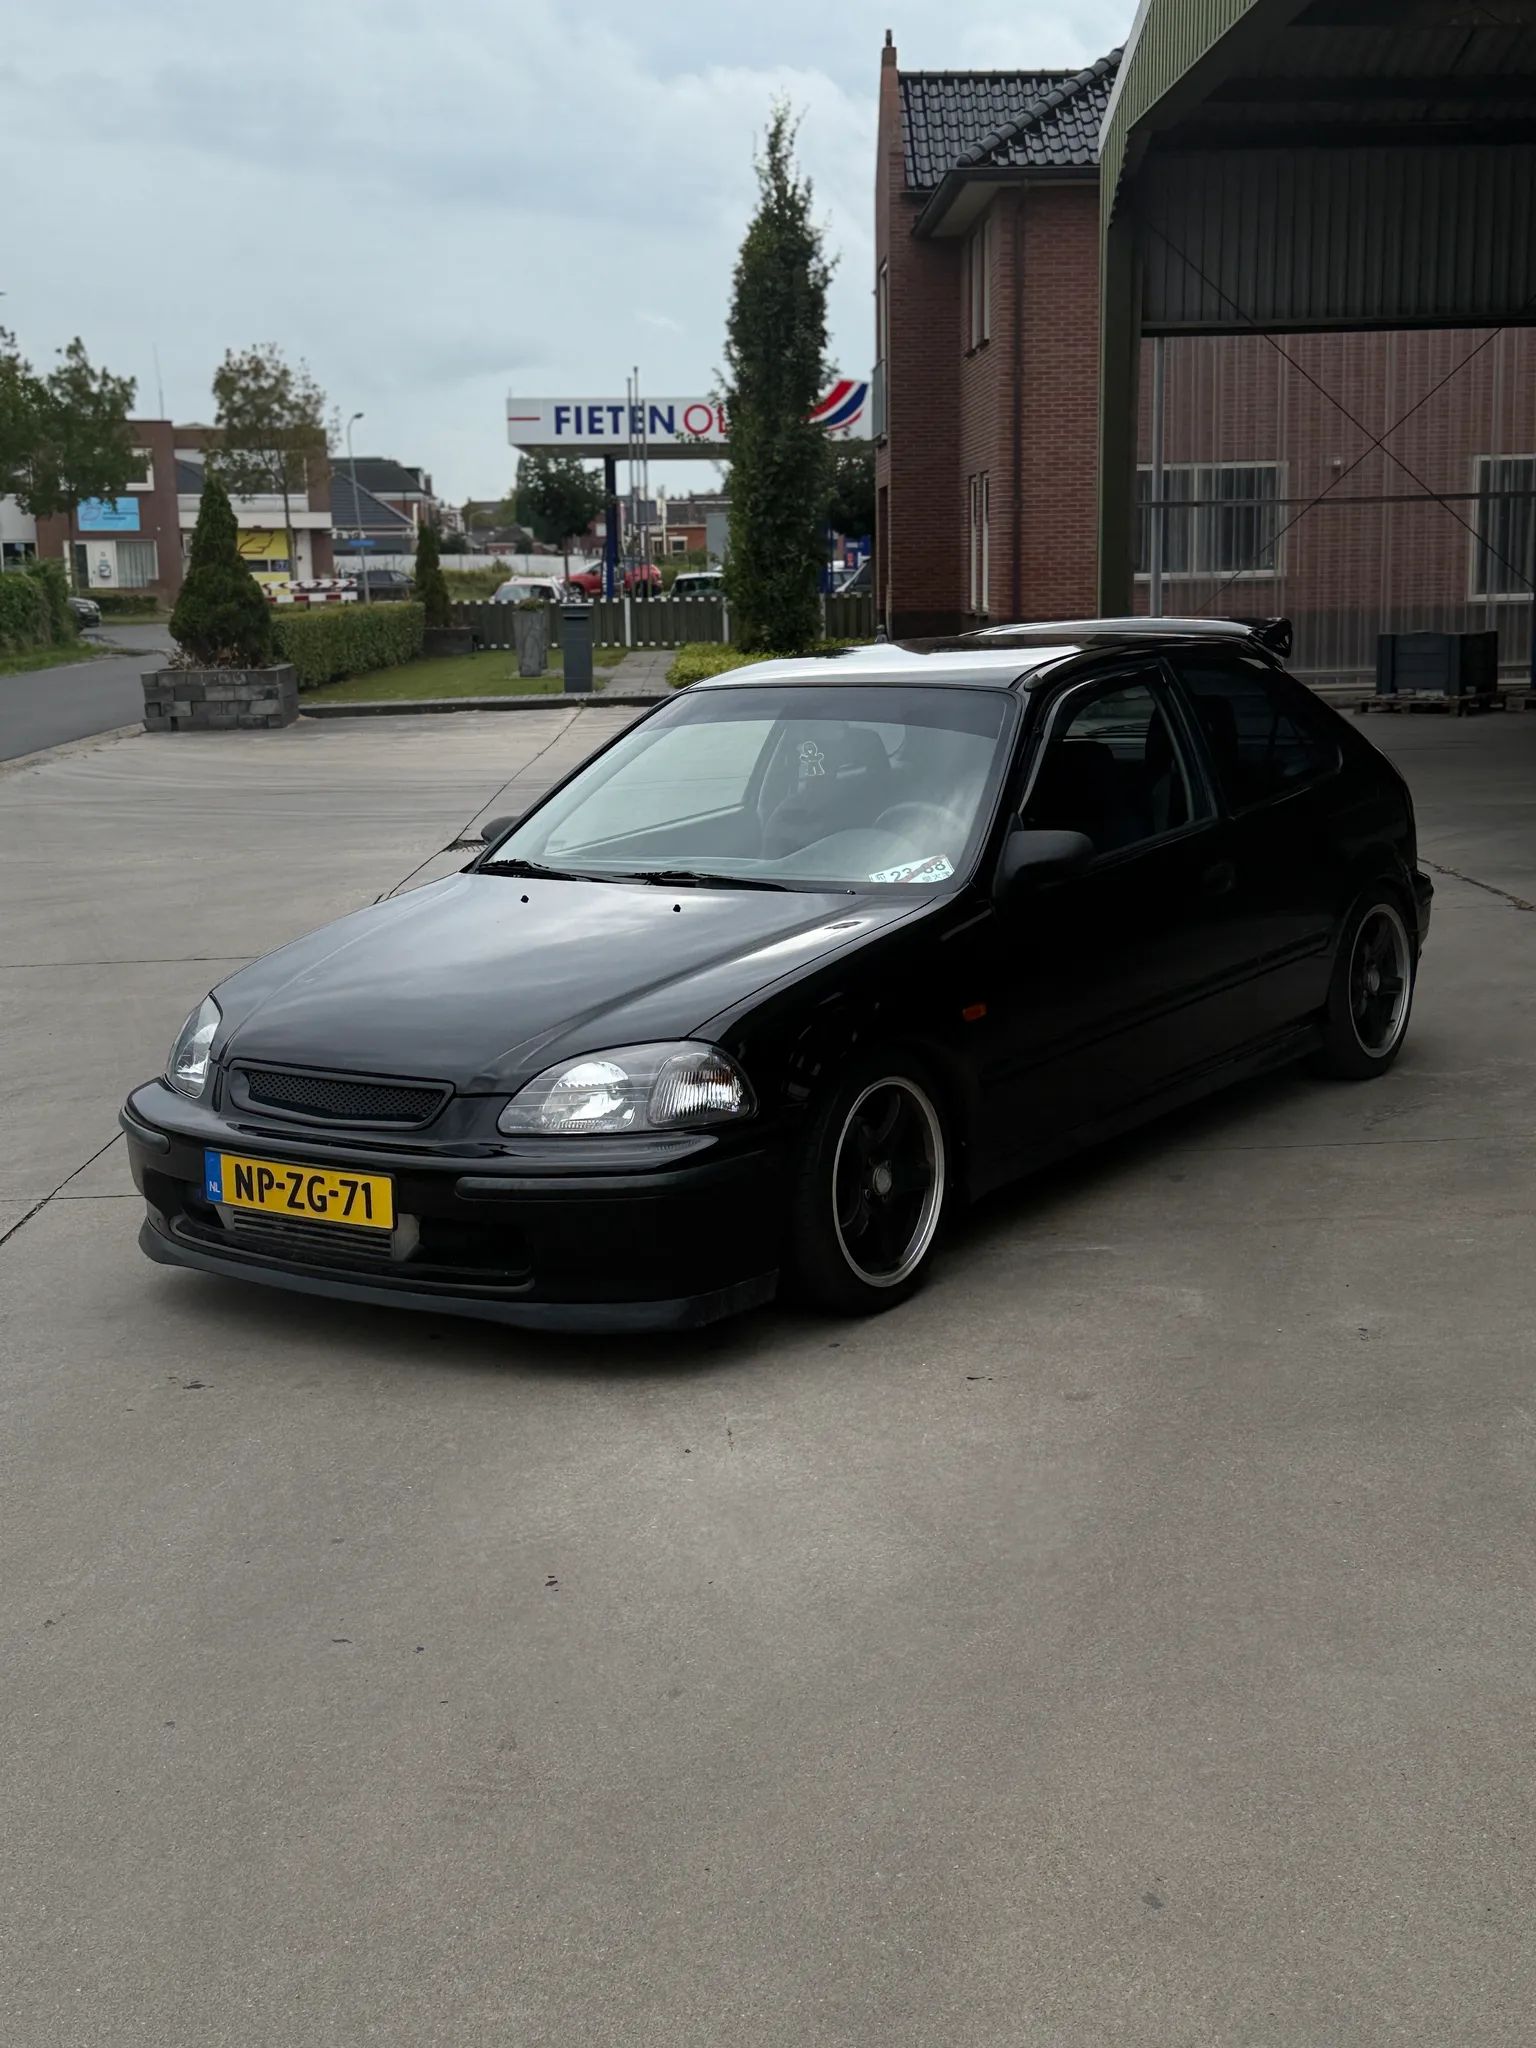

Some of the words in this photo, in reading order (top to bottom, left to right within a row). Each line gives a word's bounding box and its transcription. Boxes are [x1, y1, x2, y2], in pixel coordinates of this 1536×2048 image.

[554, 404, 675, 435] FIETEN
[209, 1180, 221, 1194] NL
[234, 1163, 373, 1220] NP-ZG-71
